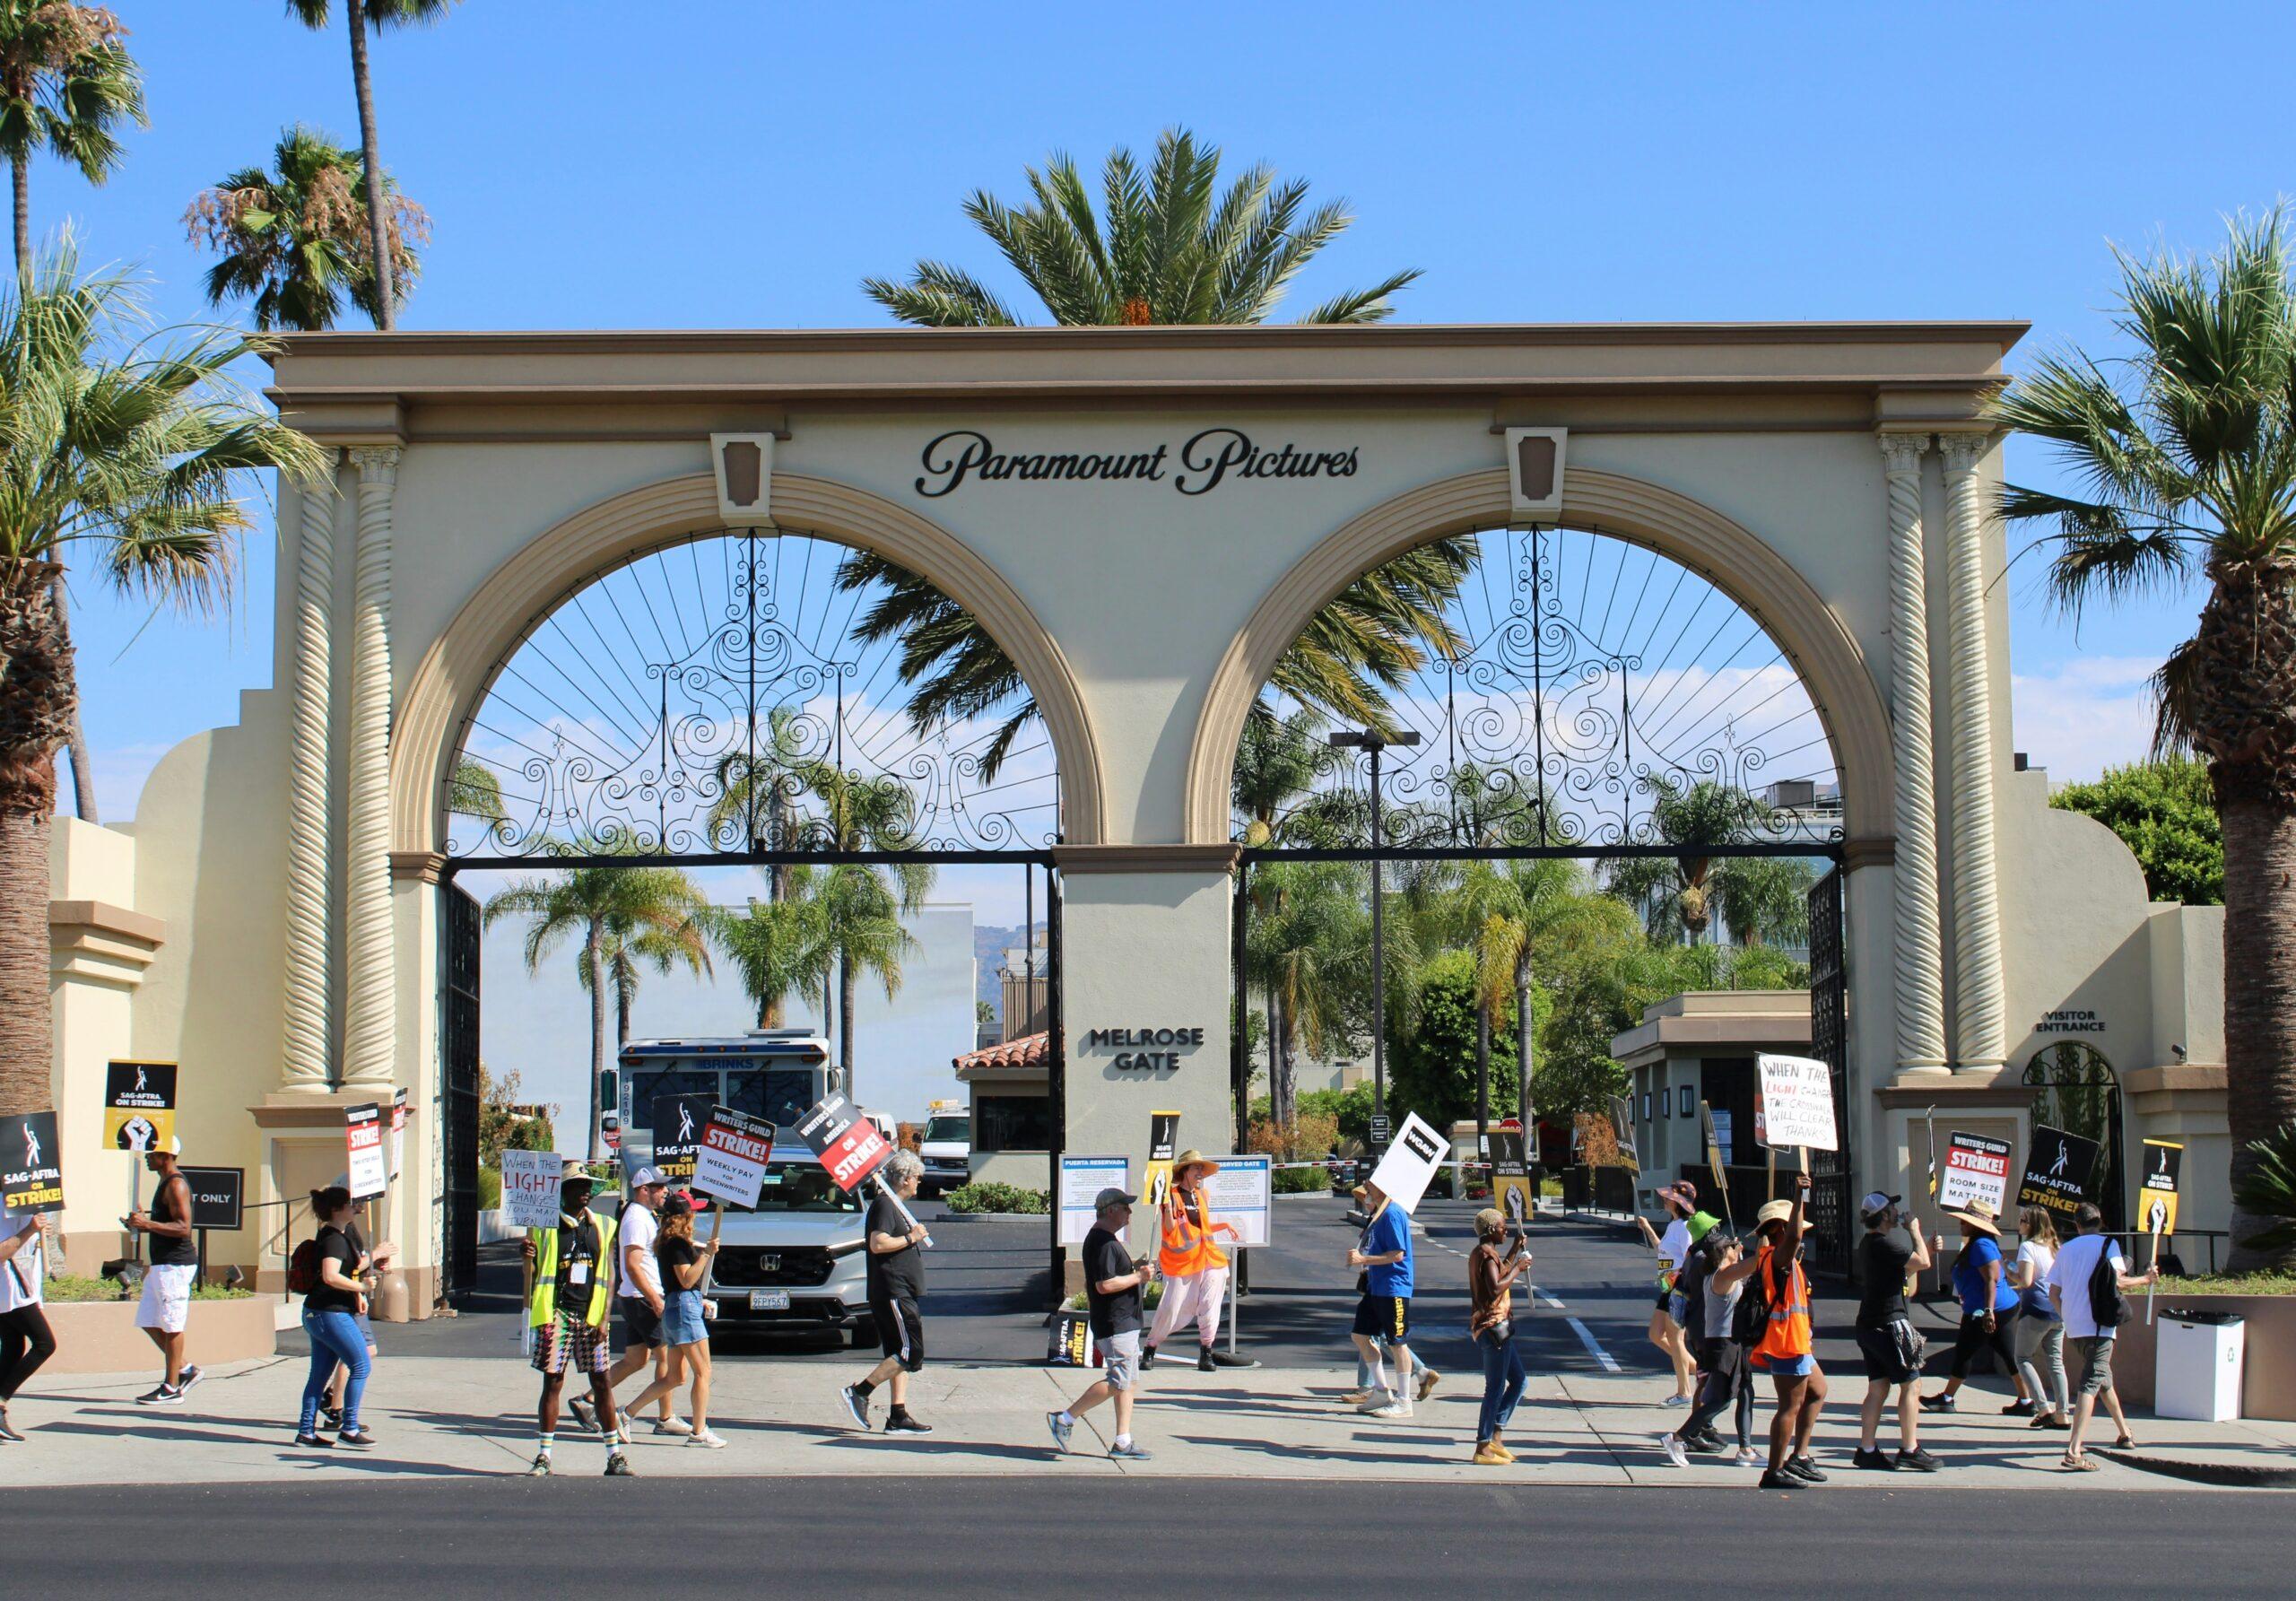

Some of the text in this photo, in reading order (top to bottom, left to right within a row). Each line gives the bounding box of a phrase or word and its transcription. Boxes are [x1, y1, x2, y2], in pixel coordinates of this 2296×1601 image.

[915, 428, 1360, 497] Paramount Pictures
[2046, 1010, 2095, 1021] VISITOR
[2036, 1022, 2106, 1032] ENTRANCE
[1091, 1028, 1204, 1047] MELROSE
[702, 1058, 754, 1069] BRINKS
[1114, 1052, 1179, 1071] GATE
[1763, 1062, 1828, 1083] WHEN THE
[1765, 1081, 1798, 1095] LIGHT
[131, 1100, 165, 1108] STRIKE!
[1770, 1098, 1787, 1108] THE
[714, 1111, 771, 1138] WRITERS GUILD
[800, 1109, 830, 1136] WRITERS
[1770, 1111, 1796, 1122] WILL
[1799, 1112, 1833, 1127] CLEAR
[822, 1118, 851, 1145] AMERICA
[1785, 1126, 1828, 1142] THANKS
[707, 1128, 768, 1162] STRIKE!
[842, 1136, 857, 1152] ON
[1408, 1130, 1436, 1158] WGAW
[1954, 1136, 2007, 1153] WRITERS GUILD
[502, 1151, 557, 1170] WHEN THE
[679, 1155, 693, 1163] ON
[834, 1133, 884, 1181] STRIKE!
[1951, 1151, 2005, 1175] STRIKE!
[659, 1163, 696, 1177] STRI
[707, 1157, 754, 1179] WEEKLY PAY
[30, 1181, 45, 1190] ON
[504, 1171, 561, 1194] LIGHT
[701, 1176, 750, 1196] SCREENWRITERS
[1950, 1178, 2001, 1193] ROOM SIZE
[5, 1188, 63, 1208] STRIKE!
[201, 1194, 231, 1203] ONLY
[1948, 1189, 1997, 1205] MATTERS
[2021, 1188, 2080, 1214] STRIKE!
[505, 1205, 556, 1217] YOU MAY
[505, 1216, 556, 1227] TURN IN
[1395, 1297, 1405, 1336] CHIGAN
[1067, 1339, 1074, 1349] ON
[1073, 1321, 1086, 1364] STRIKE!
